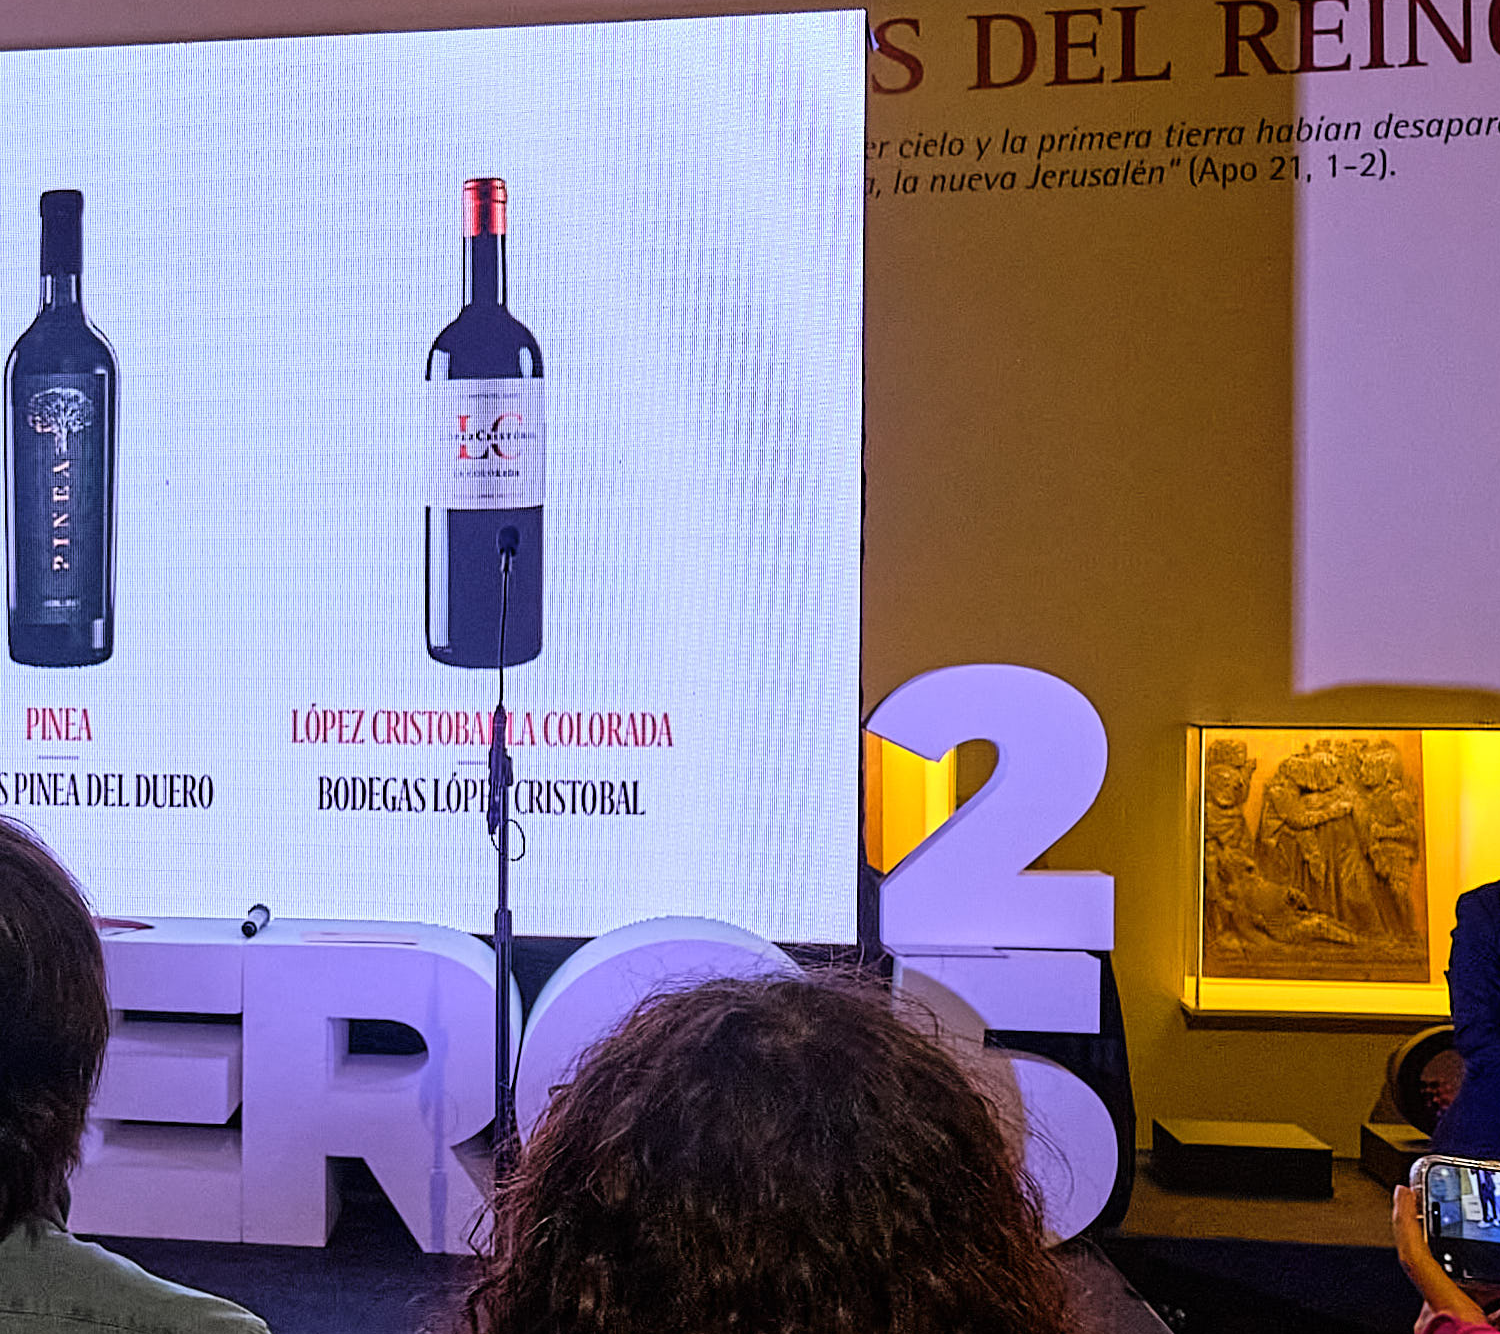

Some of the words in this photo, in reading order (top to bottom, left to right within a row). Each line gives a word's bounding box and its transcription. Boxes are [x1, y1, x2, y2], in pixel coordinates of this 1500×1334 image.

[966, 4, 1172, 91] DEL
[899, 132, 964, 159] cielo
[976, 136, 992, 161] y
[1001, 128, 1027, 154] la
[1037, 125, 1152, 160] primera
[1165, 120, 1244, 149] tierra
[893, 169, 919, 196] la
[930, 169, 1017, 195] nueva
[1189, 155, 1257, 190] (Apo
[1269, 155, 1312, 183] 21,
[53, 460, 70, 571] PINEA
[26, 707, 93, 741] PINEA
[291, 703, 364, 745] LÓPEZ
[507, 711, 536, 747] LA
[544, 711, 673, 748] COLORADA
[14, 772, 81, 806] PINEA
[87, 773, 130, 807] DEL
[135, 774, 213, 809] DUERO
[318, 776, 426, 813] BODEGAS
[514, 780, 646, 816] CRISTOBAL
